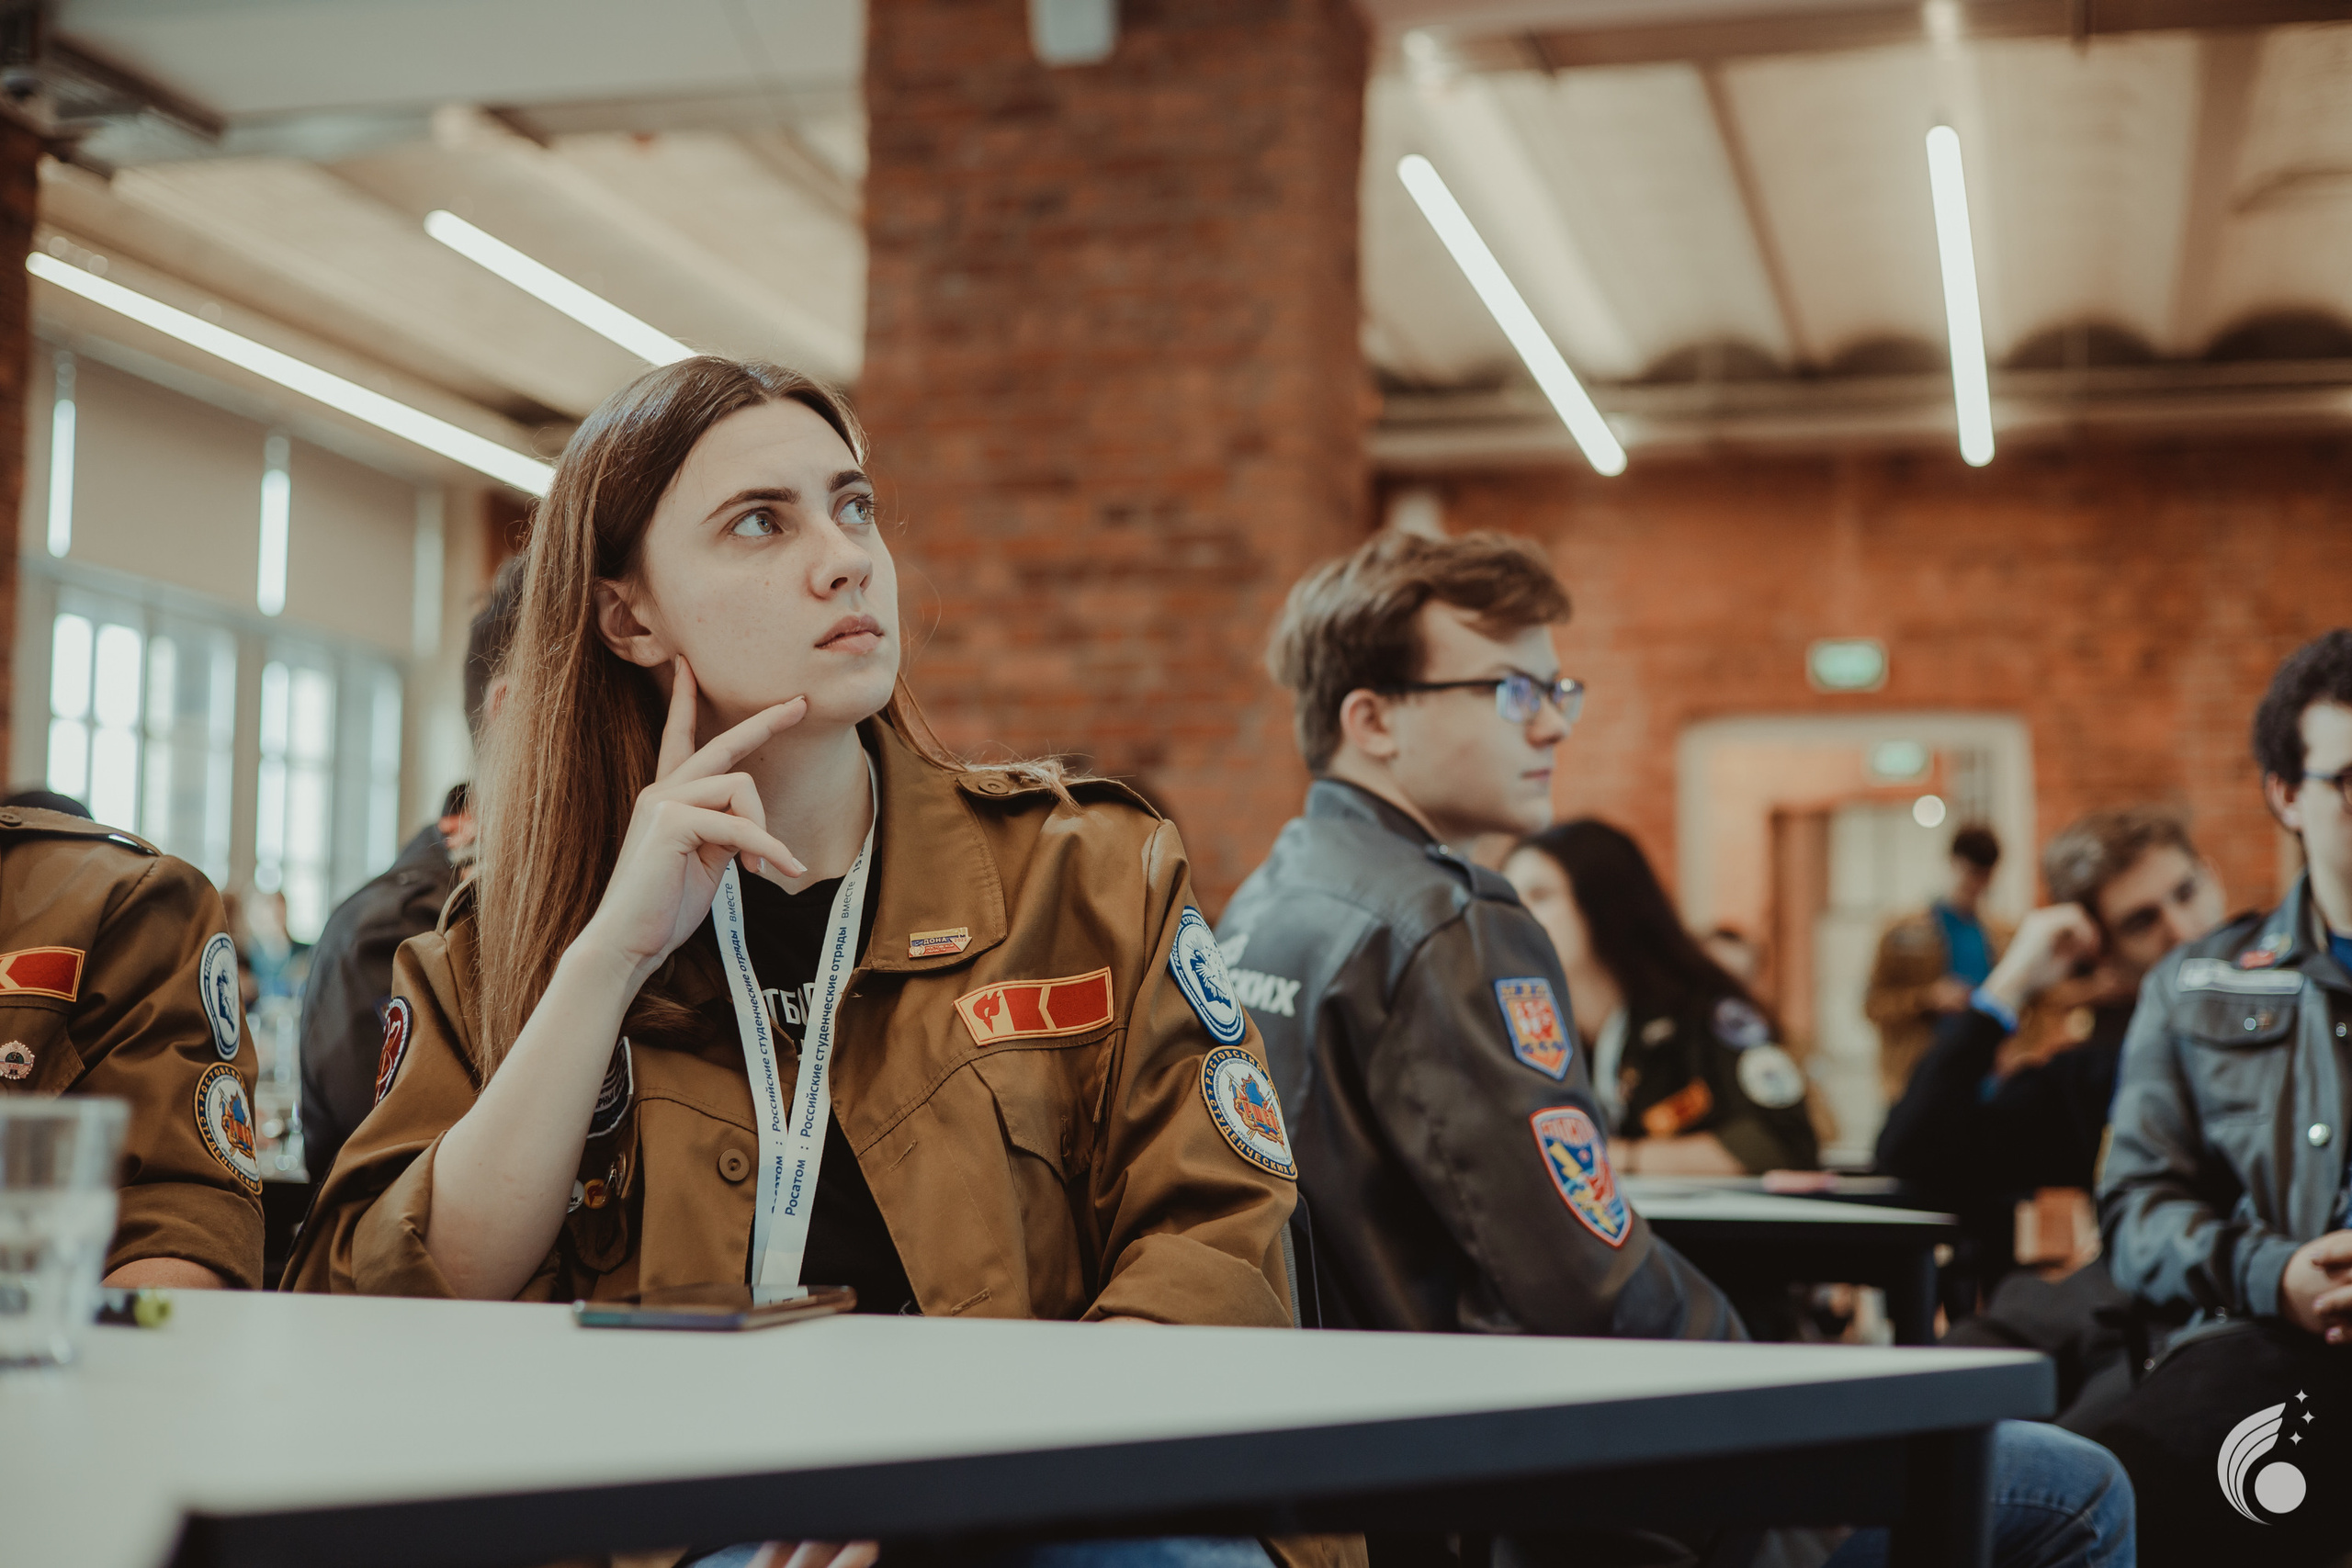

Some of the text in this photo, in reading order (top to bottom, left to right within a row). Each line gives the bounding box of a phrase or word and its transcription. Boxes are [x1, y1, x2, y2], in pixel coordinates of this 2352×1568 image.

[729, 930, 747, 972] отряды
[923, 937, 947, 945] ДОНА
[742, 975, 768, 1055] студенческие
[762, 1057, 781, 1133] Российские
[785, 1159, 806, 1216] Росатом
[800, 1064, 823, 1138] Российские
[815, 975, 838, 1062] студенческие
[831, 926, 847, 972] отряды
[1210, 1100, 1289, 1174] СТУДЕНЧЕСКИХ
